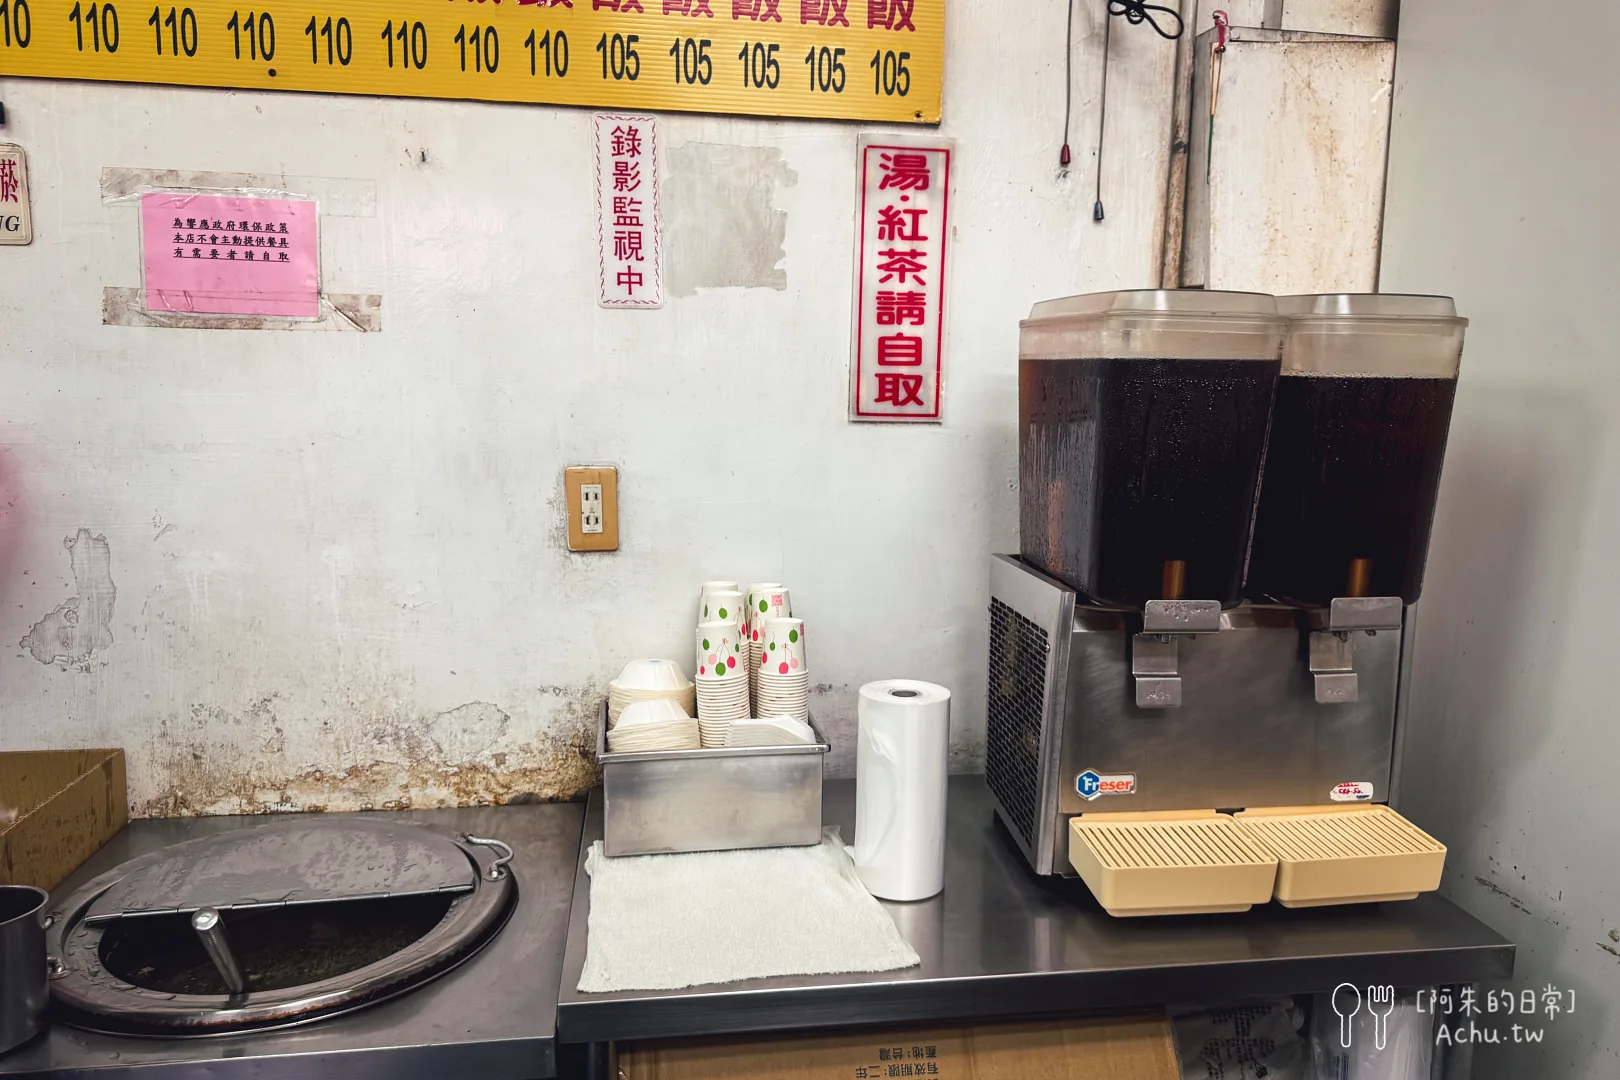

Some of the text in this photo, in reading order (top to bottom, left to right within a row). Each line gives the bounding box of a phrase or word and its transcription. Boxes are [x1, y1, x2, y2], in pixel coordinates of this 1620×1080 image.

[69, 1, 119, 53] 110
[149, 6, 197, 57] 110
[227, 11, 275, 61] 110
[305, 16, 352, 65] 110
[382, 20, 427, 69] 110
[454, 24, 499, 73] 110
[525, 29, 568, 77] 110
[597, 33, 639, 80] 105
[670, 38, 711, 84] 105
[739, 42, 779, 88] 105
[806, 47, 845, 92] 105
[871, 50, 910, 96] 105
[172, 217, 289, 234] 為響應政府環保政策
[611, 125, 645, 296] 錄影監視中
[173, 232, 289, 249] 本店不會主動提供餐具
[173, 246, 290, 262] 有需要者請自取
